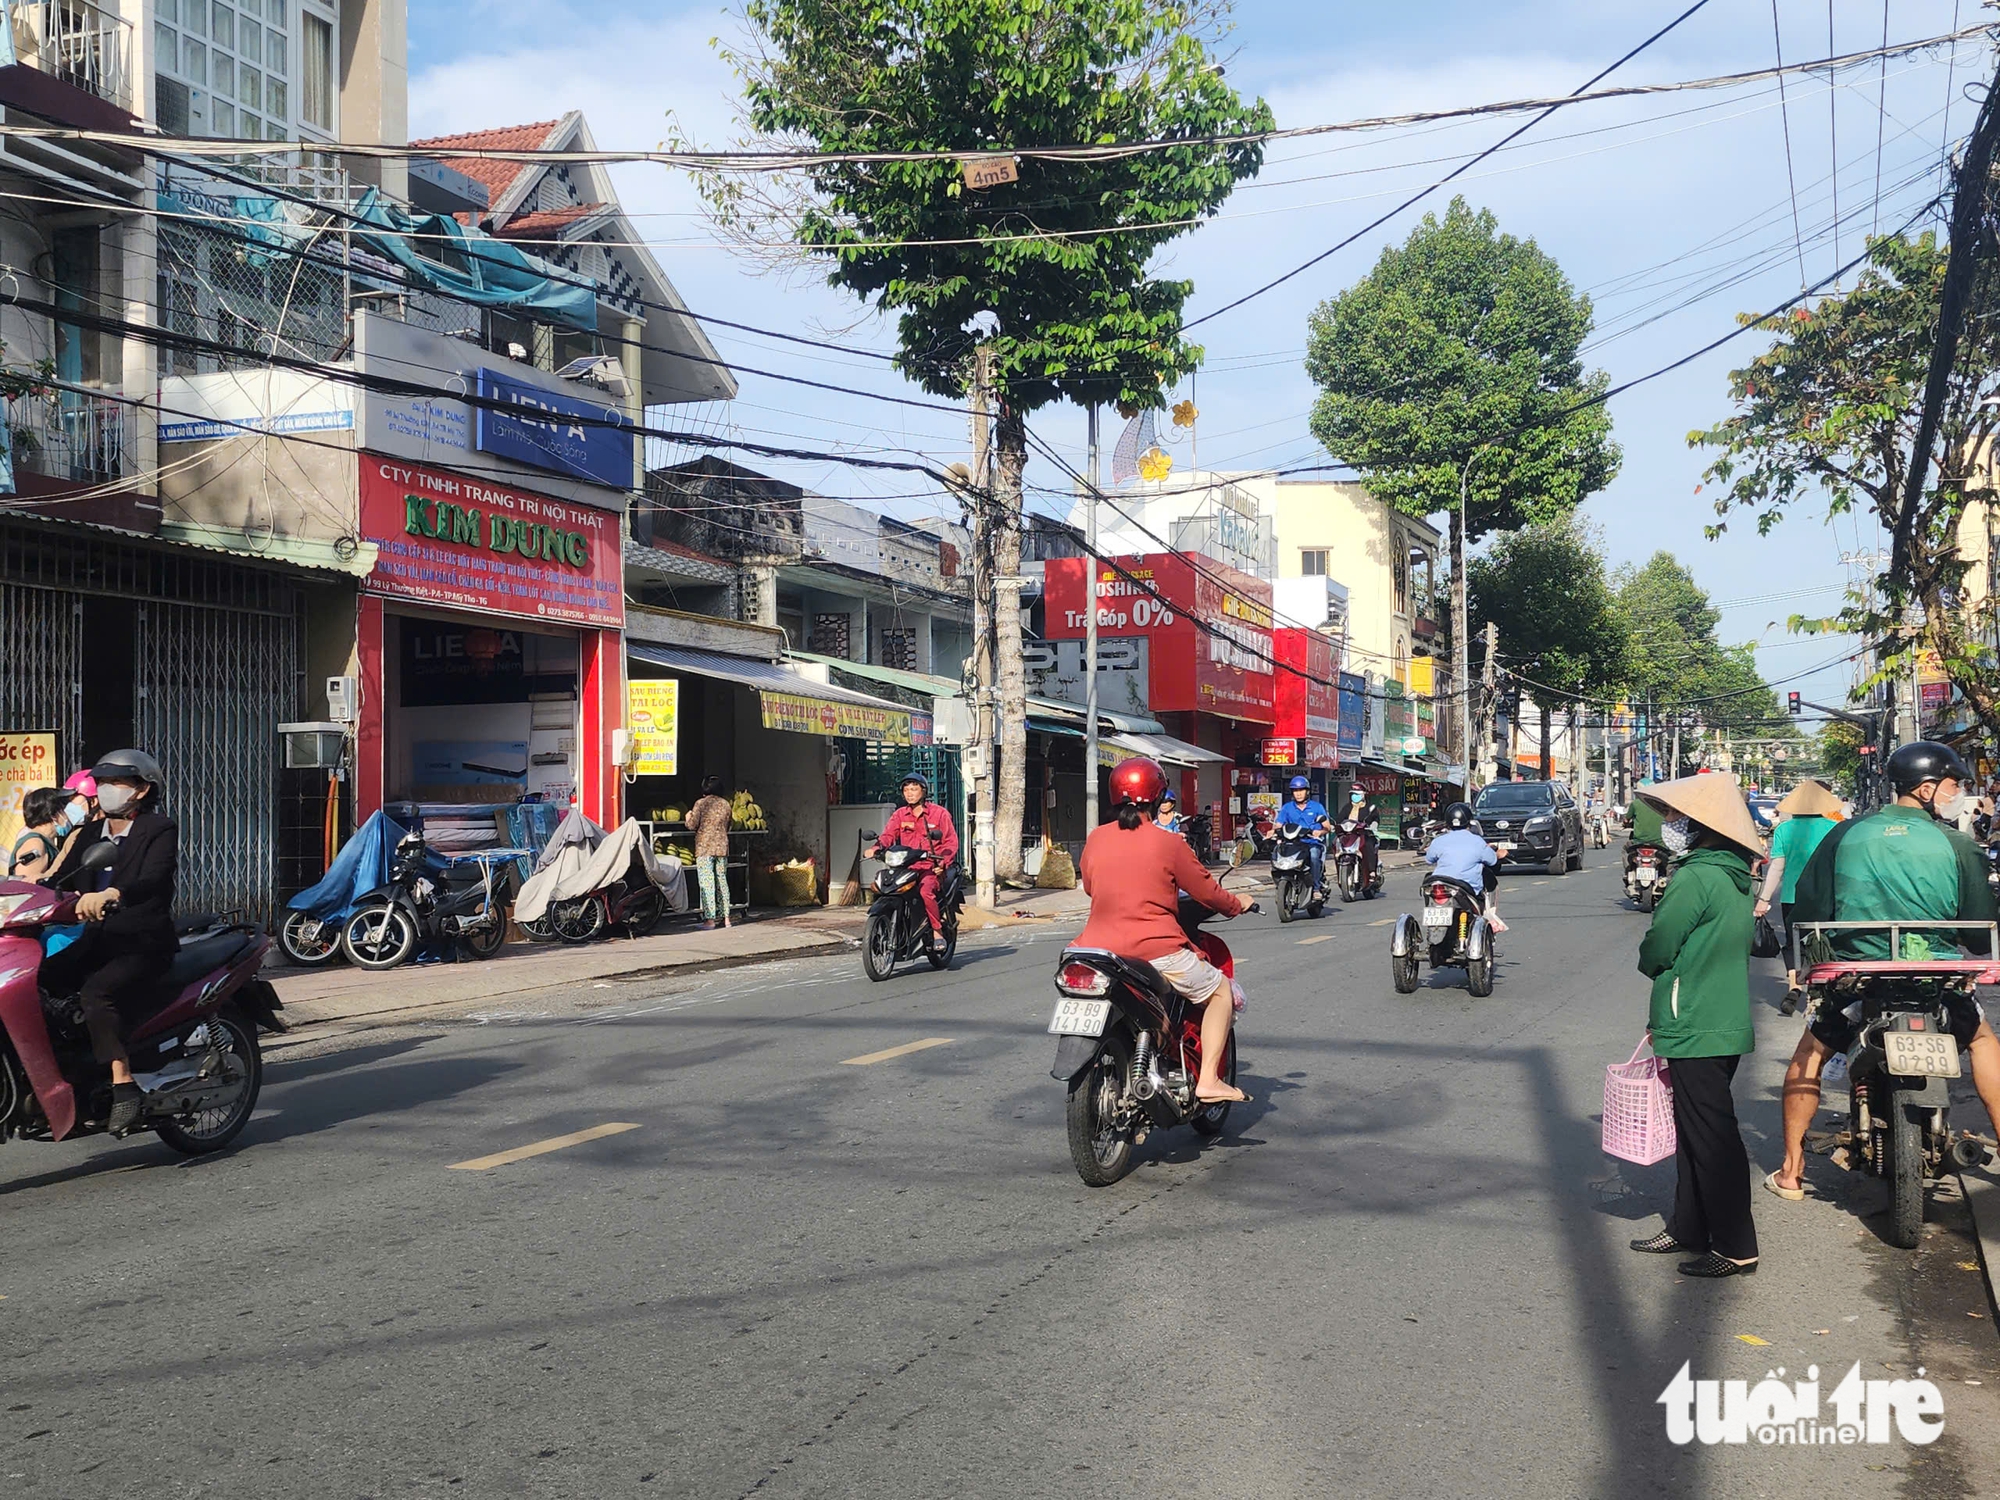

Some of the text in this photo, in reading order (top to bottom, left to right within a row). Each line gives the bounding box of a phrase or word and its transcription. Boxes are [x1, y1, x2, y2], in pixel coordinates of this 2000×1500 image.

[974, 167, 1009, 184] 4m5
[379, 464, 604, 529] CTY TNHH TRANG TRÍ NỘI THẤT
[404, 493, 588, 568] KIM DUNG
[382, 582, 390, 591] Lý
[391, 582, 416, 596] Thường
[1097, 607, 1127, 633] Góp
[1132, 598, 1174, 628] 0%
[21, 736, 46, 765] ép
[1268, 754, 1290, 764] 25k
[6, 764, 26, 781] chà
[29, 764, 43, 781] bá
[1063, 1002, 1102, 1018] 63-B9
[1054, 1016, 1102, 1034] 141.90
[1895, 1036, 1947, 1054] 63-S6
